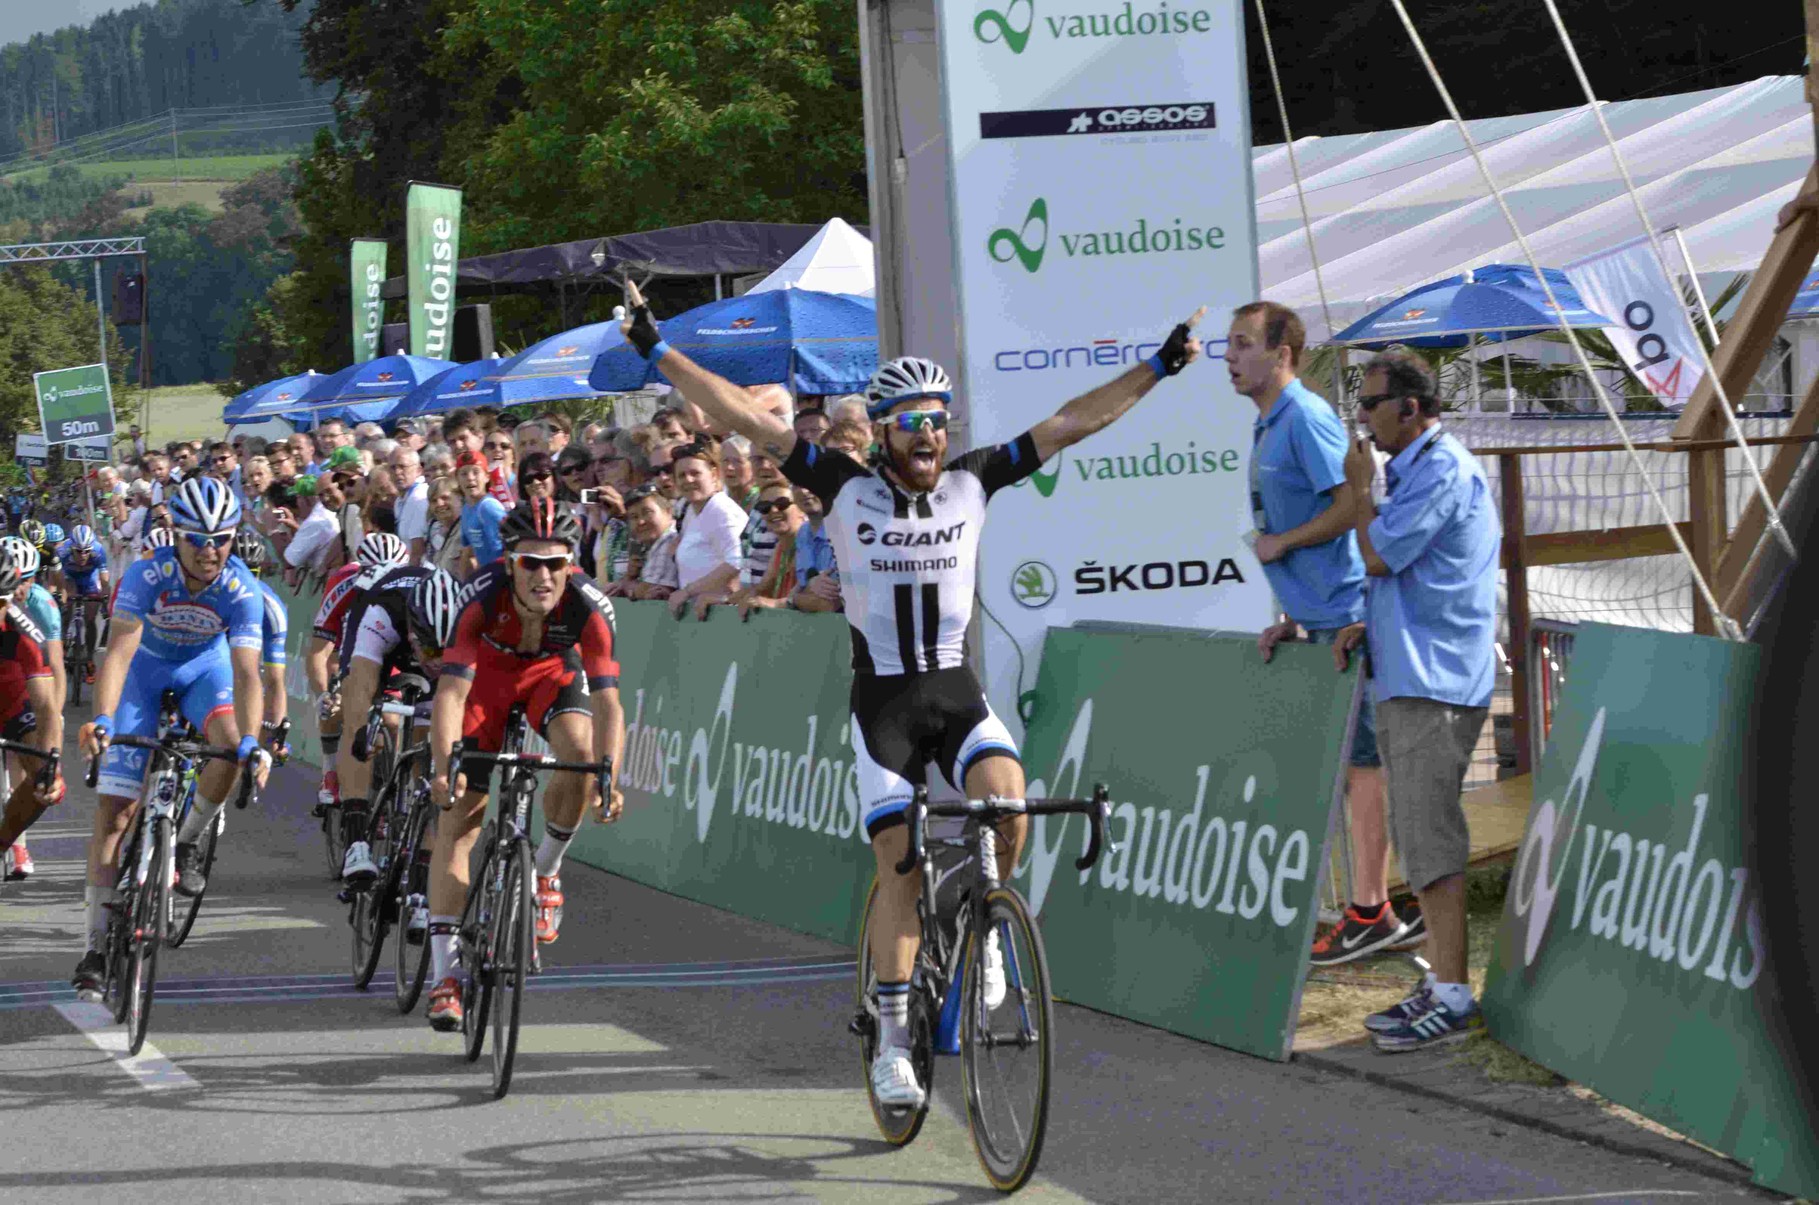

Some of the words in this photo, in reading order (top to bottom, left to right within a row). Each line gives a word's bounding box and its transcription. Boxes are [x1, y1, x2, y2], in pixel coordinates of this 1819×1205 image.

[1045, 1, 1211, 39] vaudoise
[1097, 105, 1207, 126] assos
[1059, 218, 1226, 257] vaudoise
[424, 217, 452, 360] udoise
[61, 421, 100, 436] 50m
[1074, 441, 1239, 481] vaudoise
[881, 520, 966, 547] GIANT
[1074, 558, 1246, 594] ŠKODA
[732, 714, 869, 844] vaudois
